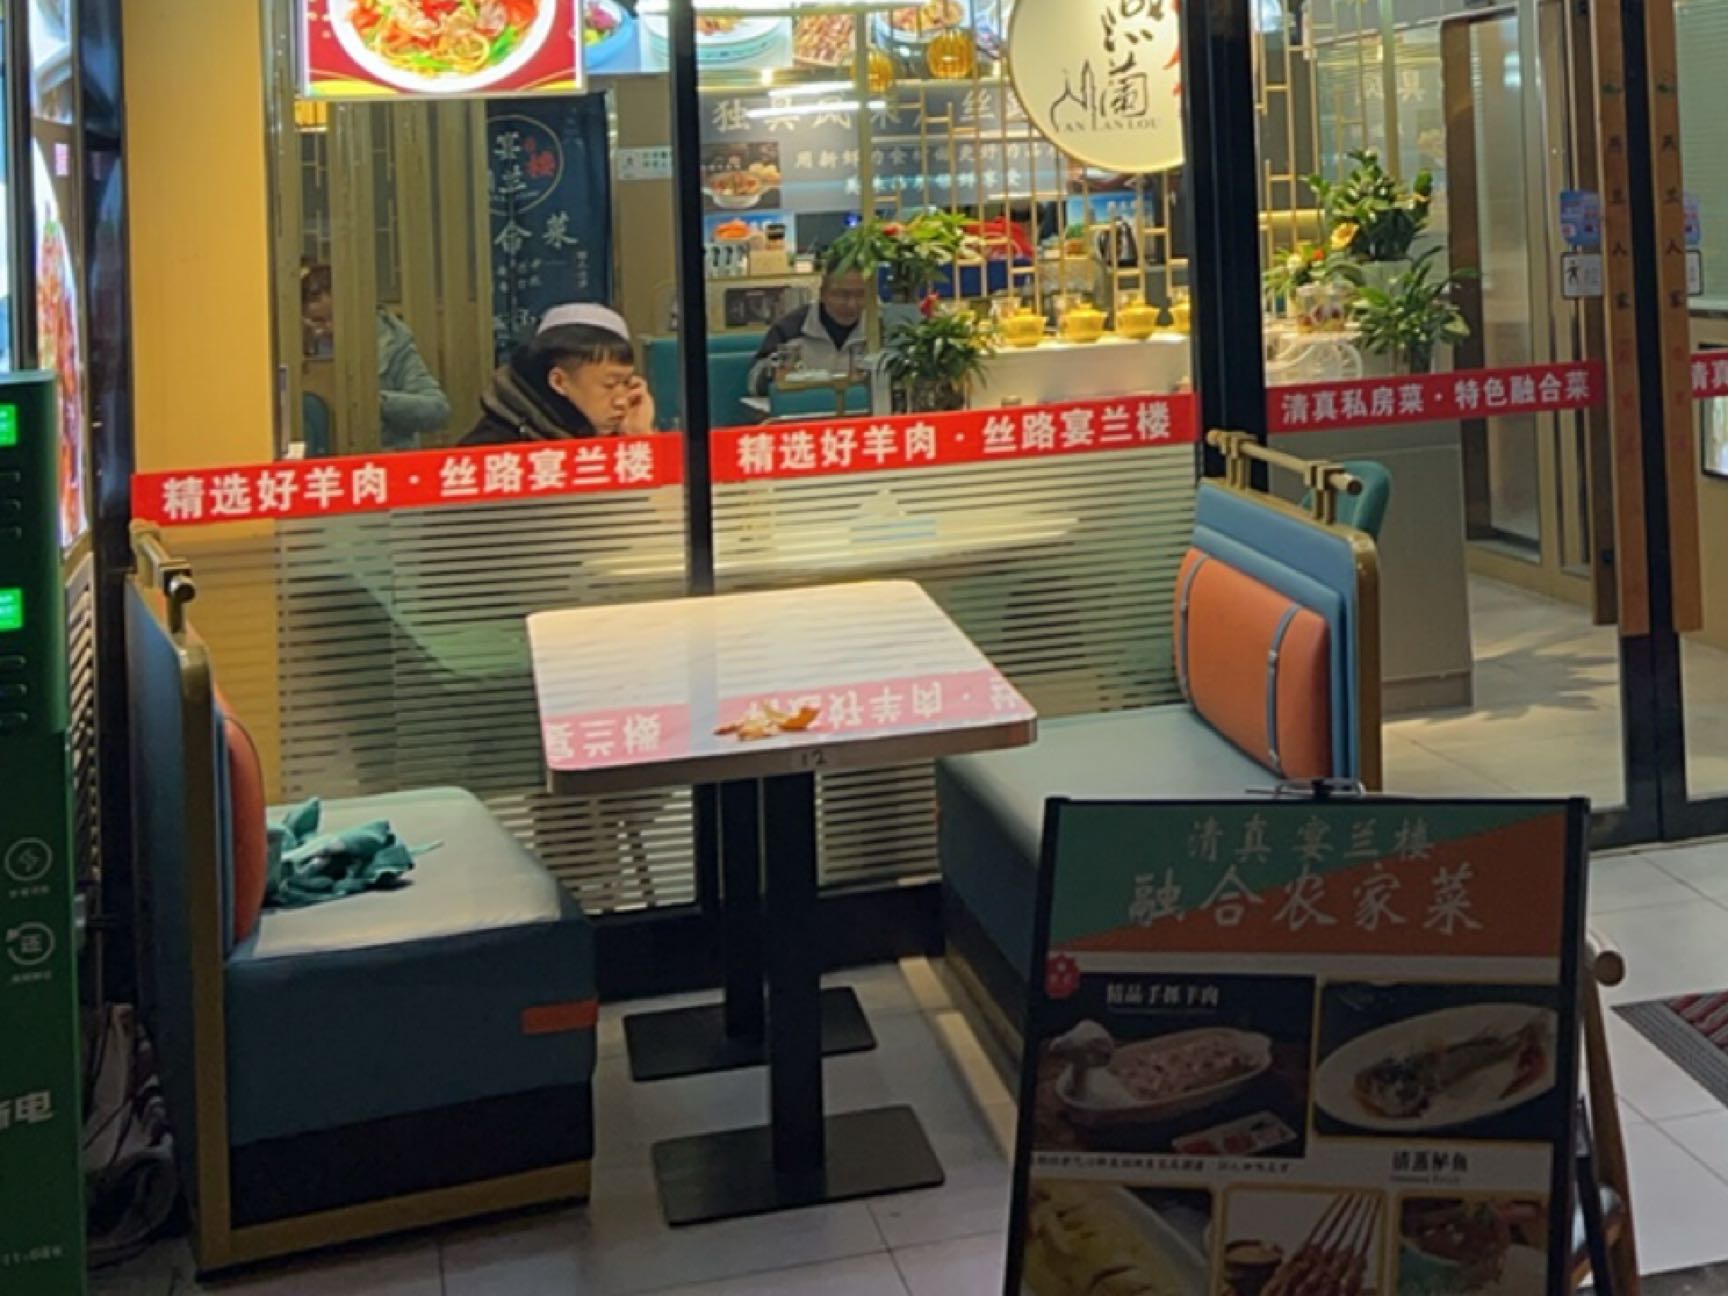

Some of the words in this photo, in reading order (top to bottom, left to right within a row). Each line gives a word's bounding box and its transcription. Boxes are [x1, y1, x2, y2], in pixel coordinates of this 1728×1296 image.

[1187, 813, 1436, 864] 清真宴兰楼
[1127, 861, 1484, 937] 融合农家菜
